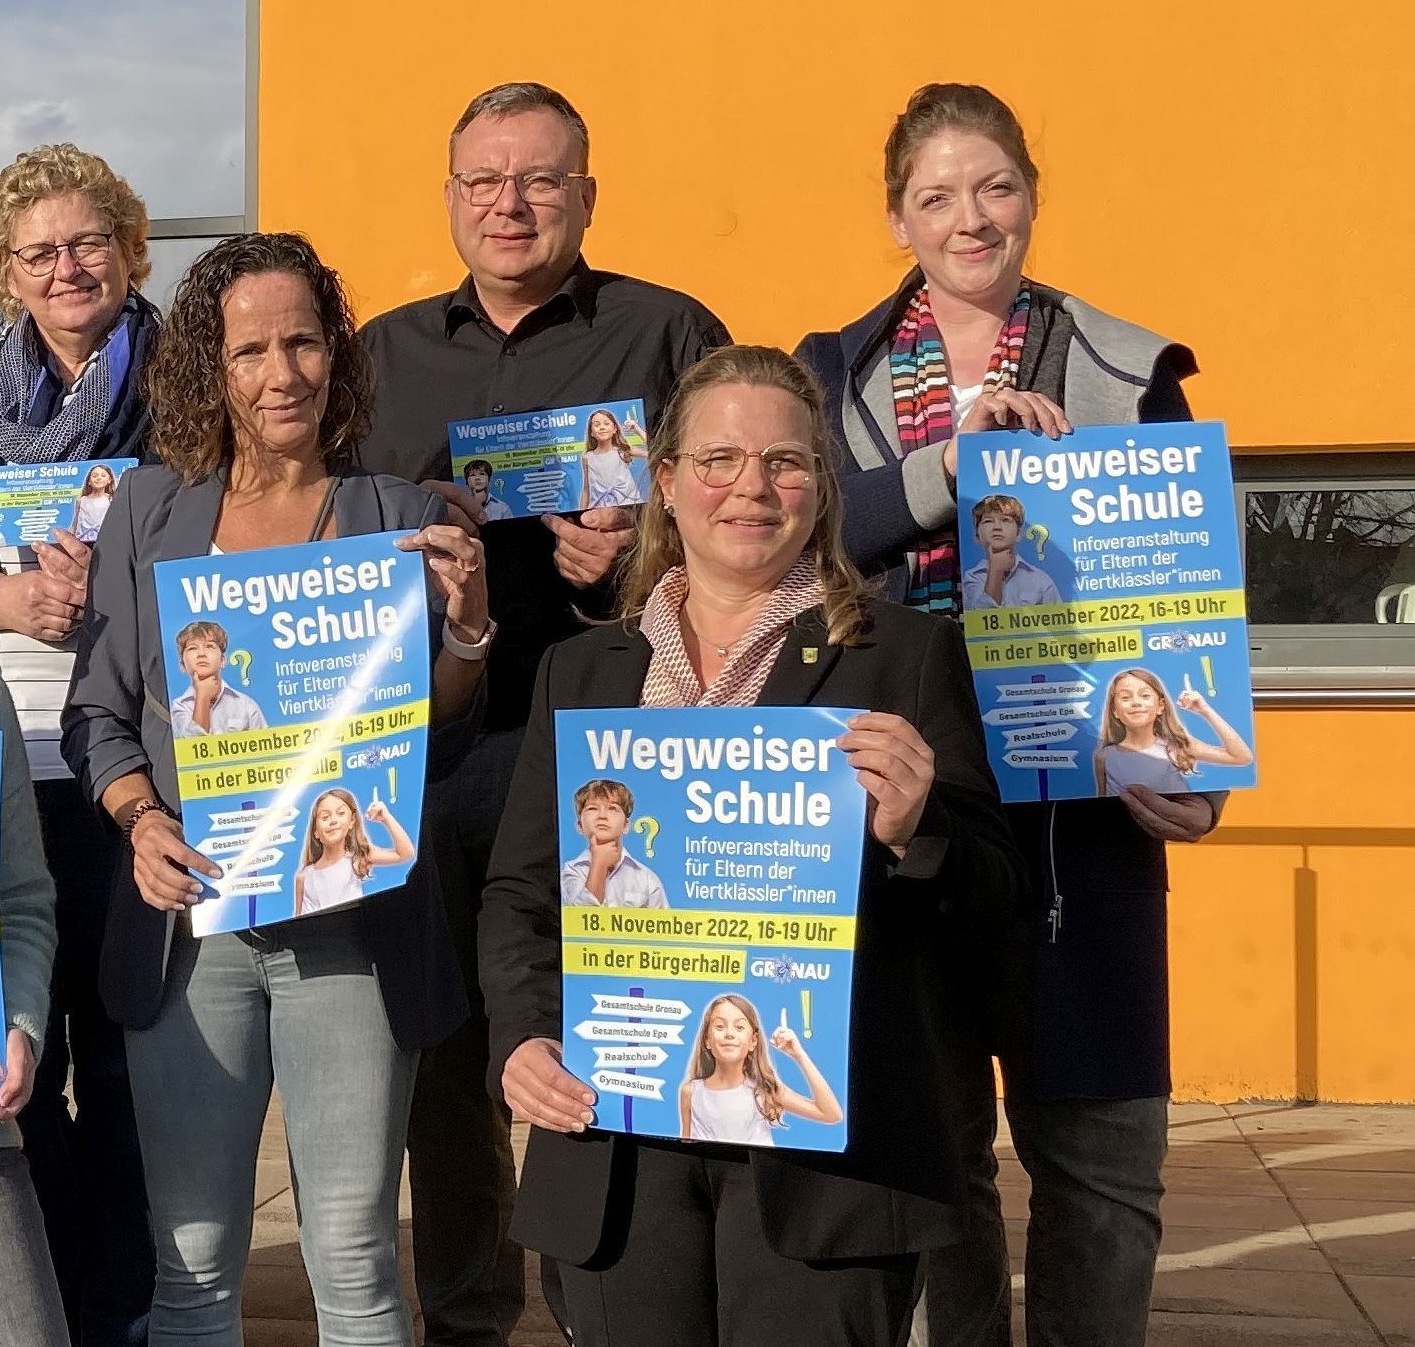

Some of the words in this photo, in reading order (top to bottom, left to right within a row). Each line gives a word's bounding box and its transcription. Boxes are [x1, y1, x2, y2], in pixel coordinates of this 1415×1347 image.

[456, 420, 530, 440] Wegweiser
[532, 413, 576, 430] Schule
[39, 465, 78, 477] Schule
[982, 439, 1202, 490] Wegweiser
[1071, 482, 1204, 526] Schule
[1074, 531, 1209, 553] Infoveranstaltung
[1073, 557, 1096, 571] für
[1102, 554, 1147, 569] Eltern
[1153, 551, 1177, 565] der
[182, 556, 397, 615] Wegweiser
[271, 600, 398, 649] Schule
[982, 615, 1003, 630] 18.
[1010, 609, 1095, 628] November
[1100, 603, 1144, 621] 2022,
[1149, 600, 1190, 617] 16-19
[1196, 598, 1226, 614] Uhr
[276, 646, 403, 677] Infoveranstag
[986, 645, 1000, 661] in
[1006, 644, 1032, 660] der
[1038, 636, 1137, 658] Bürgerhalle
[278, 681, 298, 695] für
[304, 676, 345, 693] Eltern
[192, 743, 213, 759] 18.
[218, 734, 298, 756] November
[348, 717, 384, 737] 16-19
[389, 711, 414, 728] Uhr
[586, 726, 837, 780] Wegweiser
[196, 774, 211, 790] in
[216, 772, 242, 788] der
[686, 781, 831, 826] Schule
[686, 837, 831, 862] Infoveranstaltung
[685, 858, 709, 876] für
[716, 860, 762, 877] Eltern
[769, 862, 795, 879] der
[582, 914, 605, 931] 18.
[612, 915, 702, 935] November
[707, 919, 752, 941] 2022,
[758, 921, 799, 940] 16-19
[806, 923, 837, 941] Uhr
[583, 947, 598, 966] in
[605, 950, 634, 968] der
[640, 952, 740, 974] Bürgerhalle
